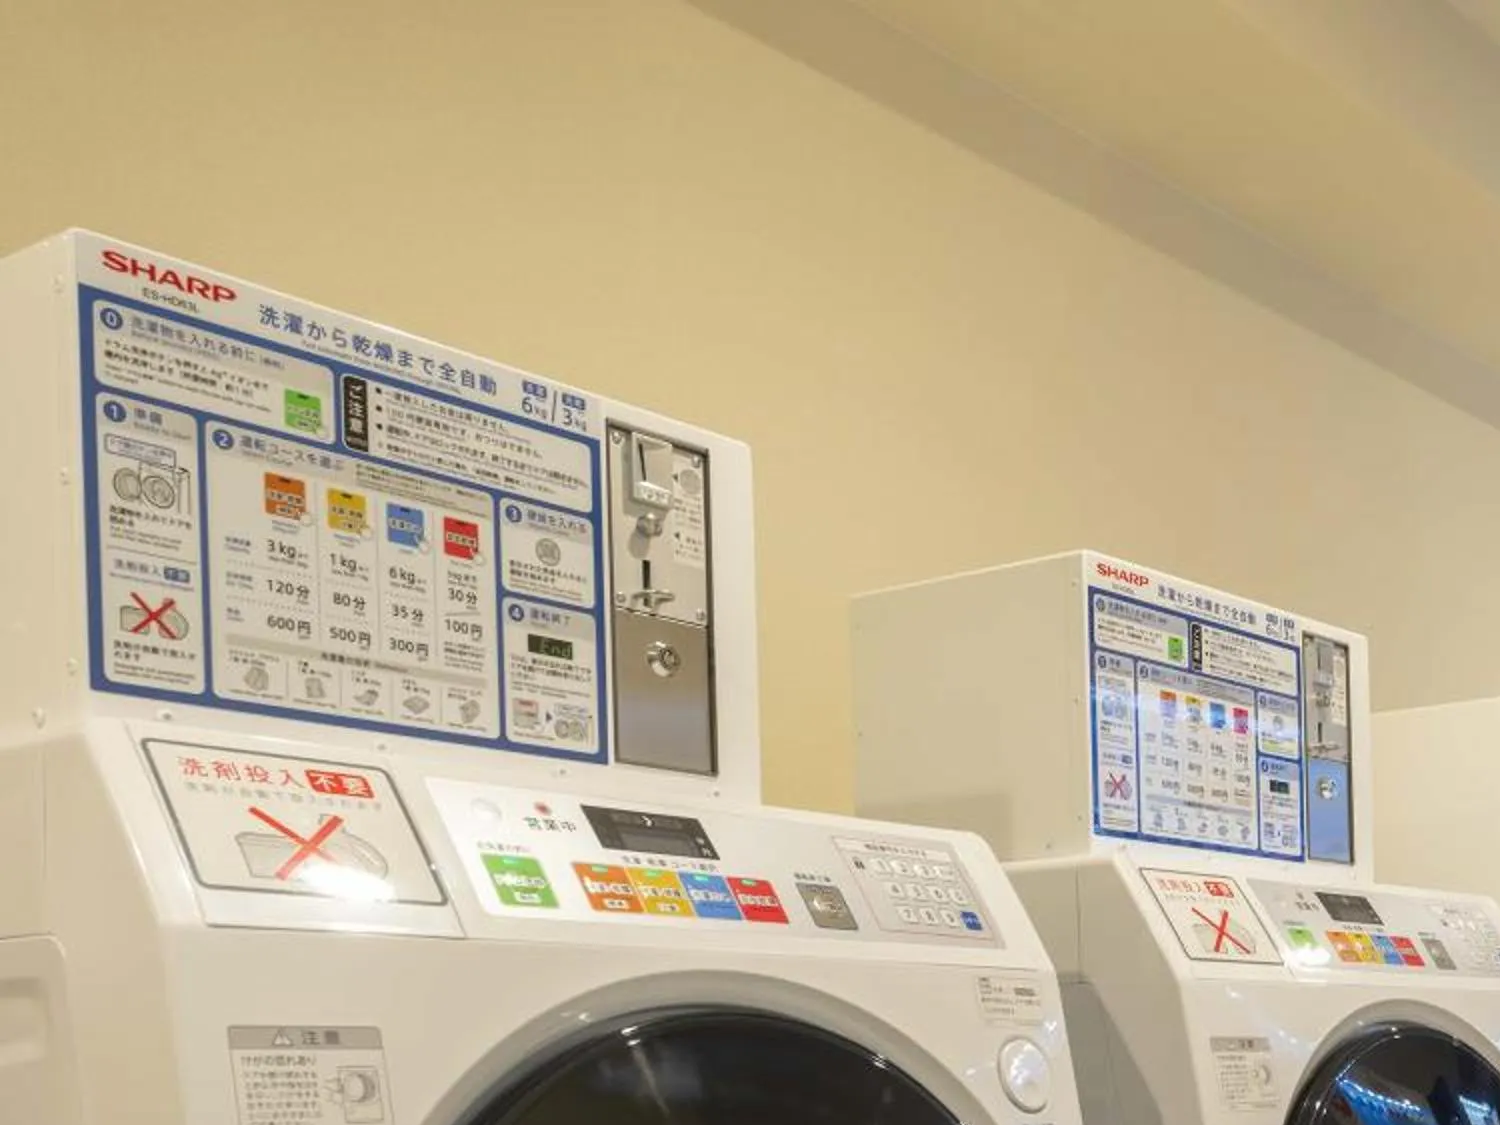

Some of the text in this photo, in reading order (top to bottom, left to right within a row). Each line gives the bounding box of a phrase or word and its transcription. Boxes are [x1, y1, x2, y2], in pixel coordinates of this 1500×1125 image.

[101, 249, 238, 302] SHARP
[258, 302, 498, 397] 洗濯から乾燥まで全自動
[266, 579, 310, 601] 120分
[1095, 561, 1150, 588] SHARP
[266, 614, 311, 635] 600円
[329, 627, 371, 647] 500円
[389, 637, 429, 658] 300円
[444, 619, 483, 639] 100円
[179, 756, 305, 789] 洗剤投入
